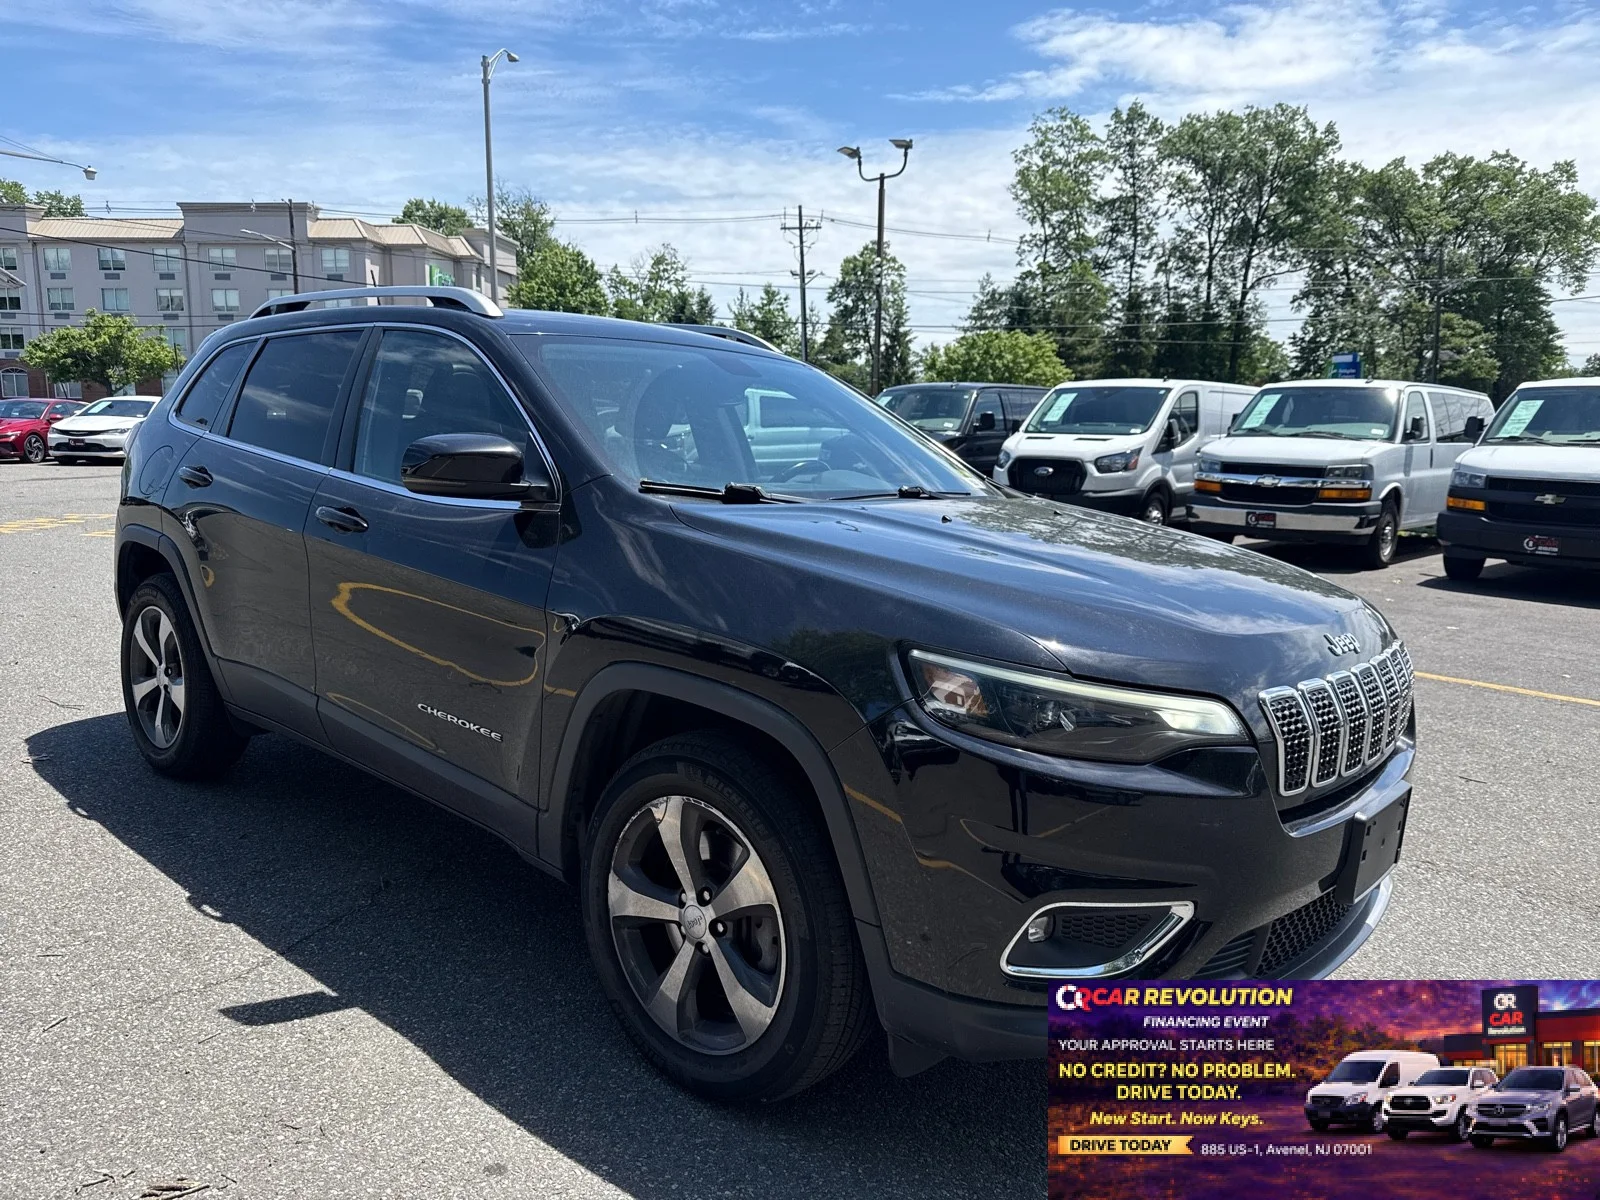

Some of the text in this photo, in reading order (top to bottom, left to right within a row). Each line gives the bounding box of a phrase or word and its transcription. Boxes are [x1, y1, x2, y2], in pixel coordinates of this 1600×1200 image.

[1324, 632, 1361, 656] Jeep
[417, 703, 503, 742] CHEROKEE
[705, 775, 769, 837] MICHELIN
